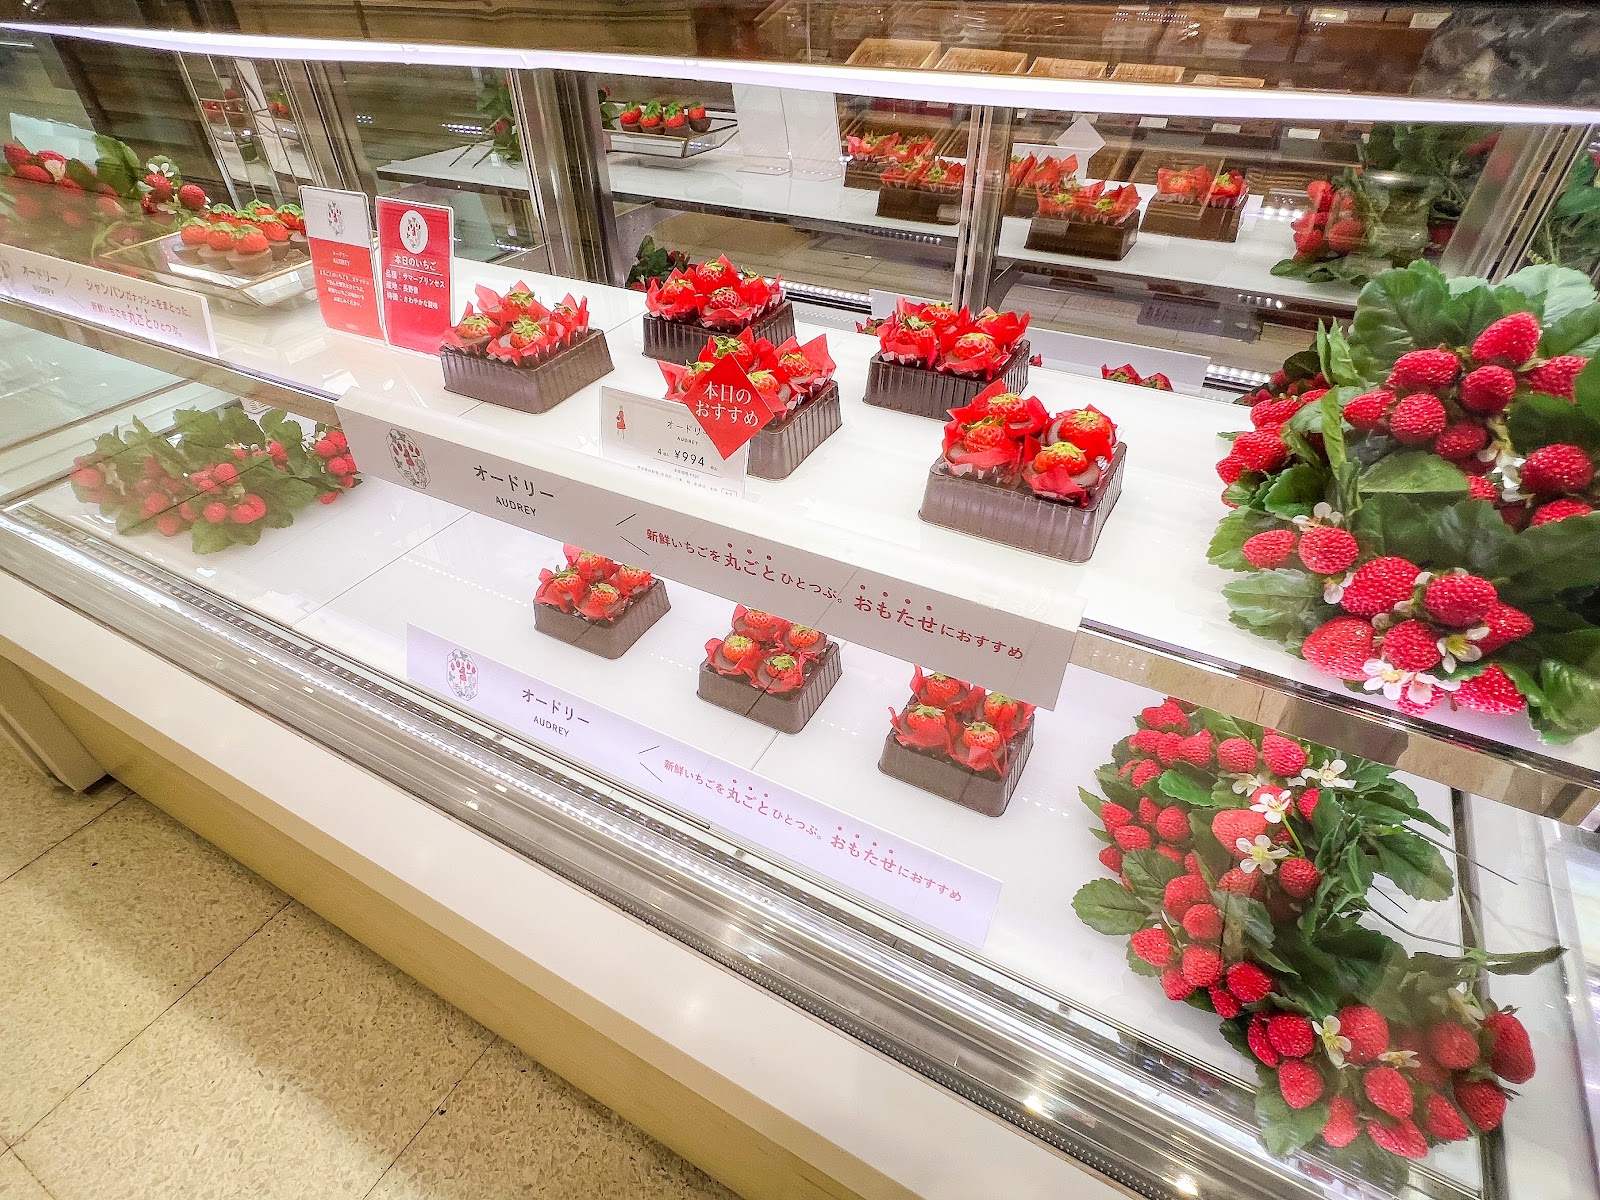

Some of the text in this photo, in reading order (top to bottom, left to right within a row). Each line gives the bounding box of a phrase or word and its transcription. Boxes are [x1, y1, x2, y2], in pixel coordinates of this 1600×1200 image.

[394, 254, 437, 271] 本日のいちご
[21, 265, 58, 283] オードリー
[703, 381, 752, 405] 本日の
[695, 400, 759, 428] おすすめ
[676, 436, 699, 446] AUDREY
[674, 449, 705, 468] ¥994
[473, 464, 555, 499] オードリー
[495, 496, 538, 517] AUDREY
[521, 688, 591, 725] オードリー
[533, 715, 570, 738] AUDREY
